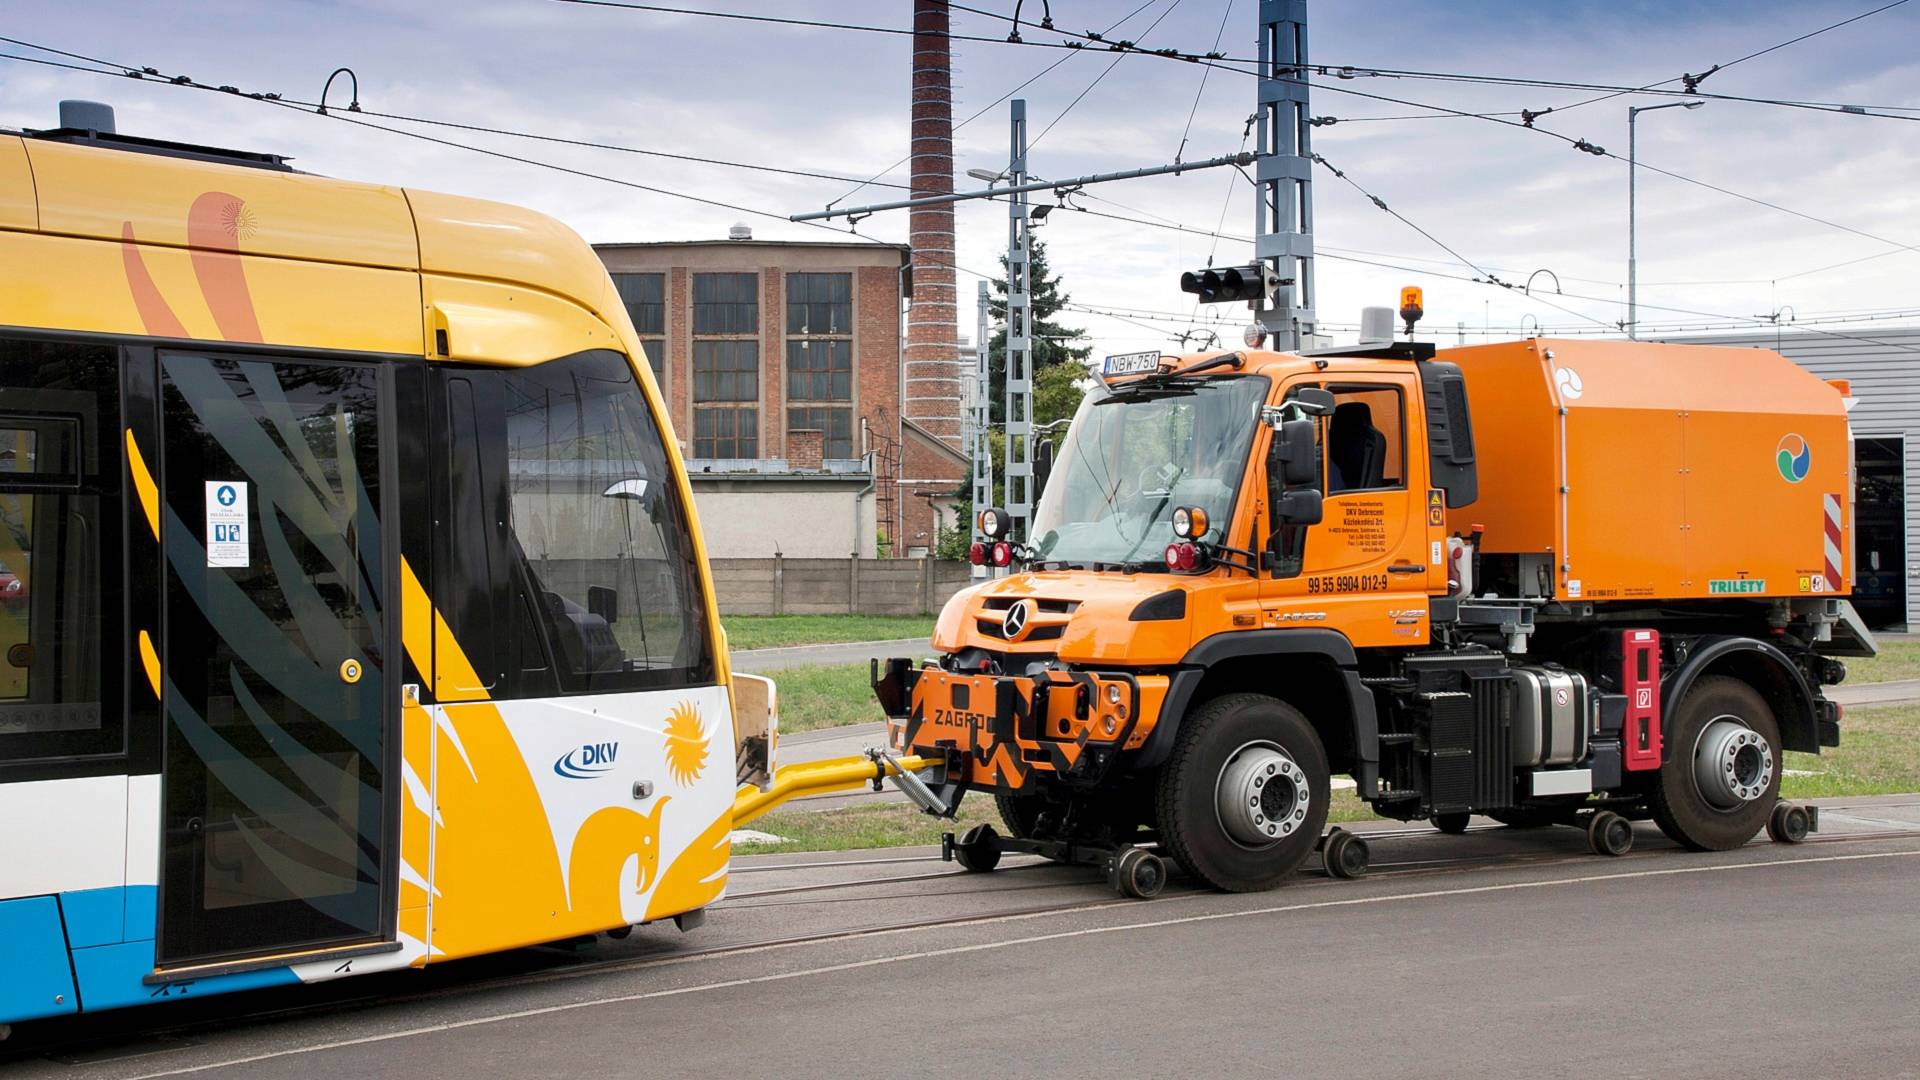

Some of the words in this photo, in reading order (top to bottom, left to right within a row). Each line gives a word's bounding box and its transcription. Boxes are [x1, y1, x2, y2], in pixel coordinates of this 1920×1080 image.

[1112, 354, 1156, 371] NBW-750
[1346, 508, 1357, 516] DKV
[1358, 508, 1384, 516] Debreceni
[1308, 577, 1320, 593] 99
[1322, 576, 1334, 592] 55
[1337, 576, 1359, 592] 9904
[1361, 574, 1388, 591] 012-9
[1710, 581, 1764, 593] TRILETY
[582, 741, 619, 765] DKV
